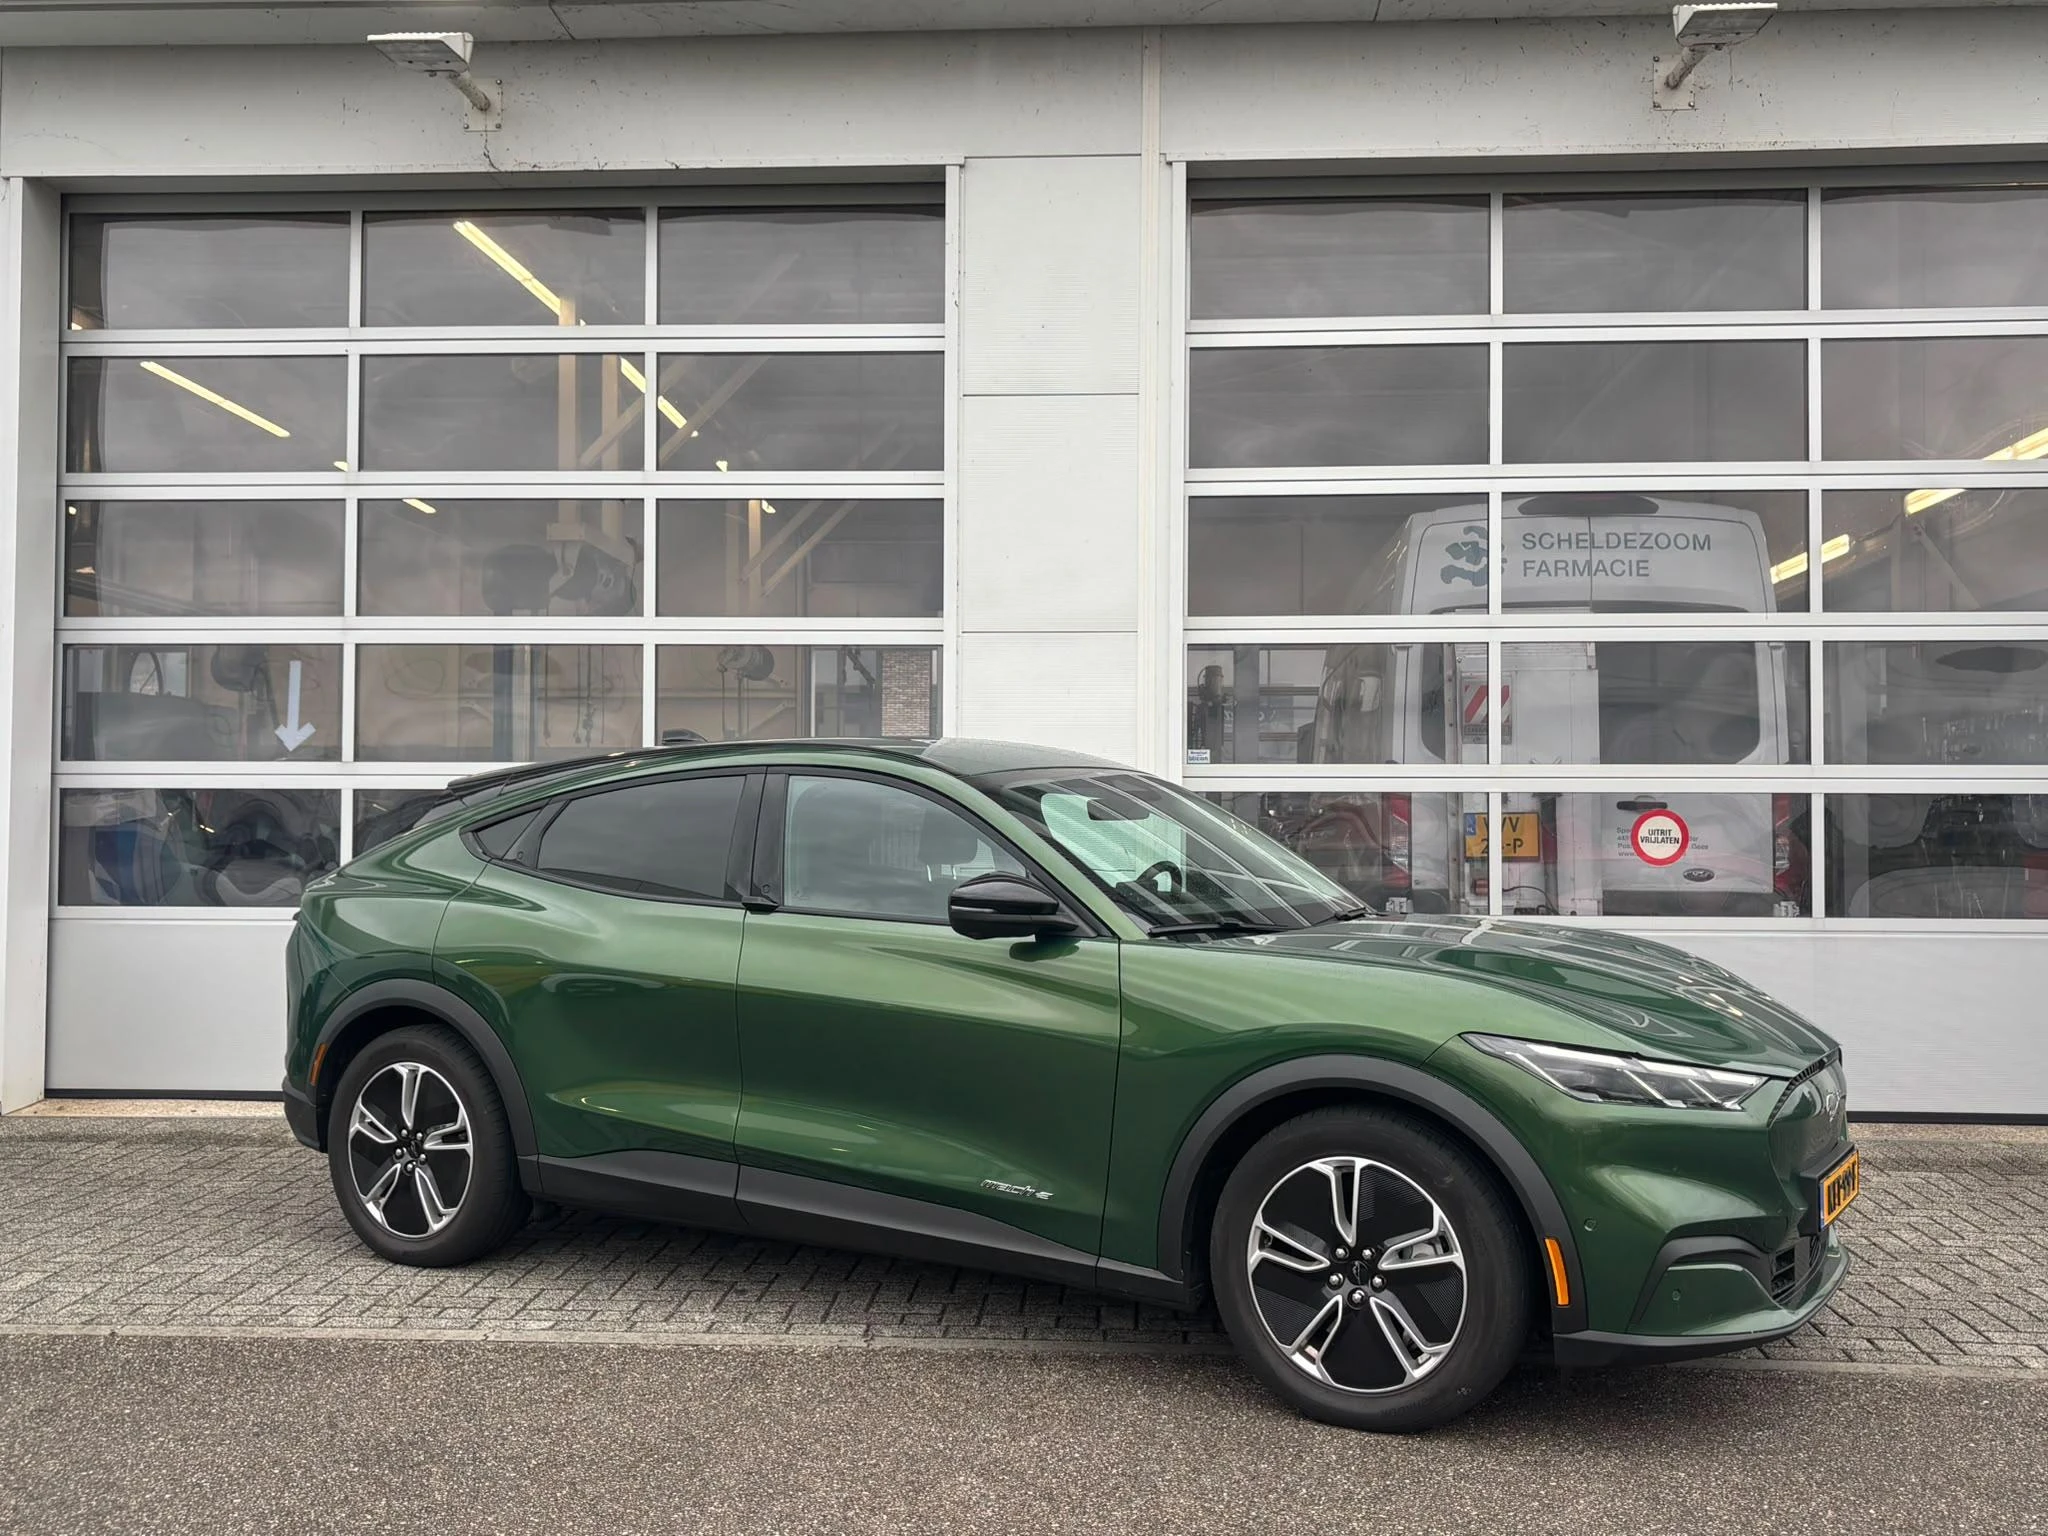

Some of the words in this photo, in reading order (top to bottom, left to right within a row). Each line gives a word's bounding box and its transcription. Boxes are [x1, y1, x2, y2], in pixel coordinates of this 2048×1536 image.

[1521, 532, 1712, 551] SCHELDEZOOM
[1522, 558, 1650, 578] FARMACIE
[1639, 836, 1680, 845] VRIJLATEN
[1647, 828, 1673, 837] UITRIT
[1480, 837, 1524, 854] 2-P
